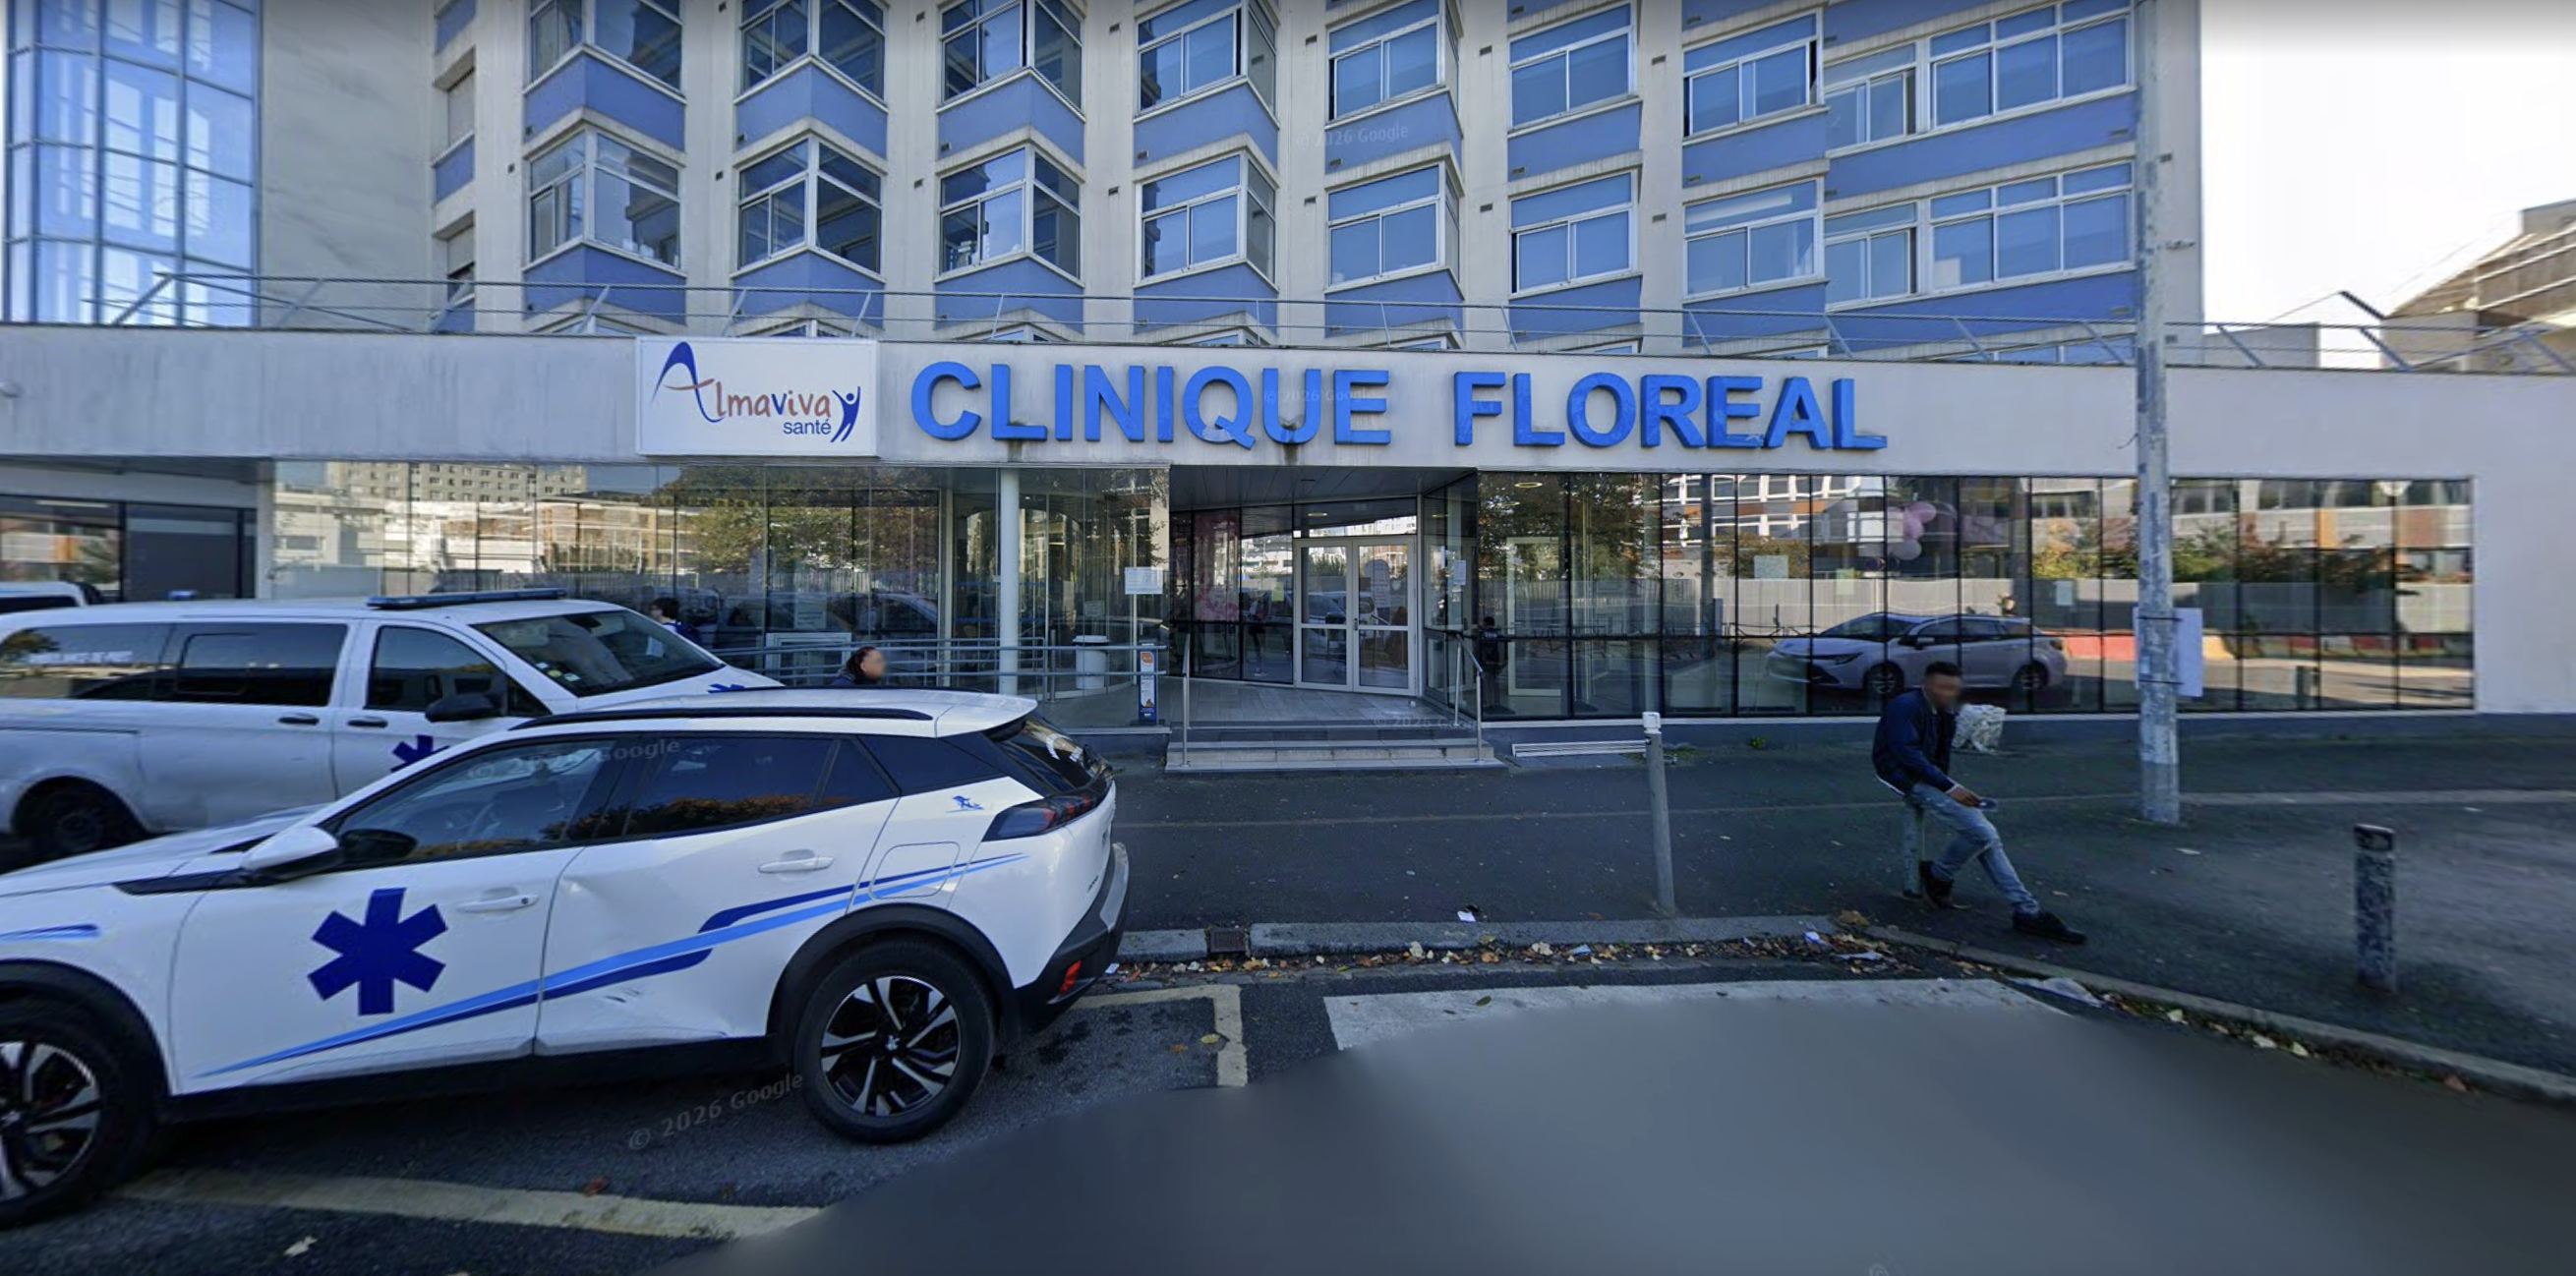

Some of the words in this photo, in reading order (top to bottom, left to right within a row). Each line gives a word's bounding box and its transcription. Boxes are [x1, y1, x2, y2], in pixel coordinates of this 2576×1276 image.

[651, 341, 832, 423] Almaviva
[911, 361, 1391, 450] CLINIQUE
[1453, 372, 1889, 450] FLOREAL
[783, 418, 832, 435] santé
